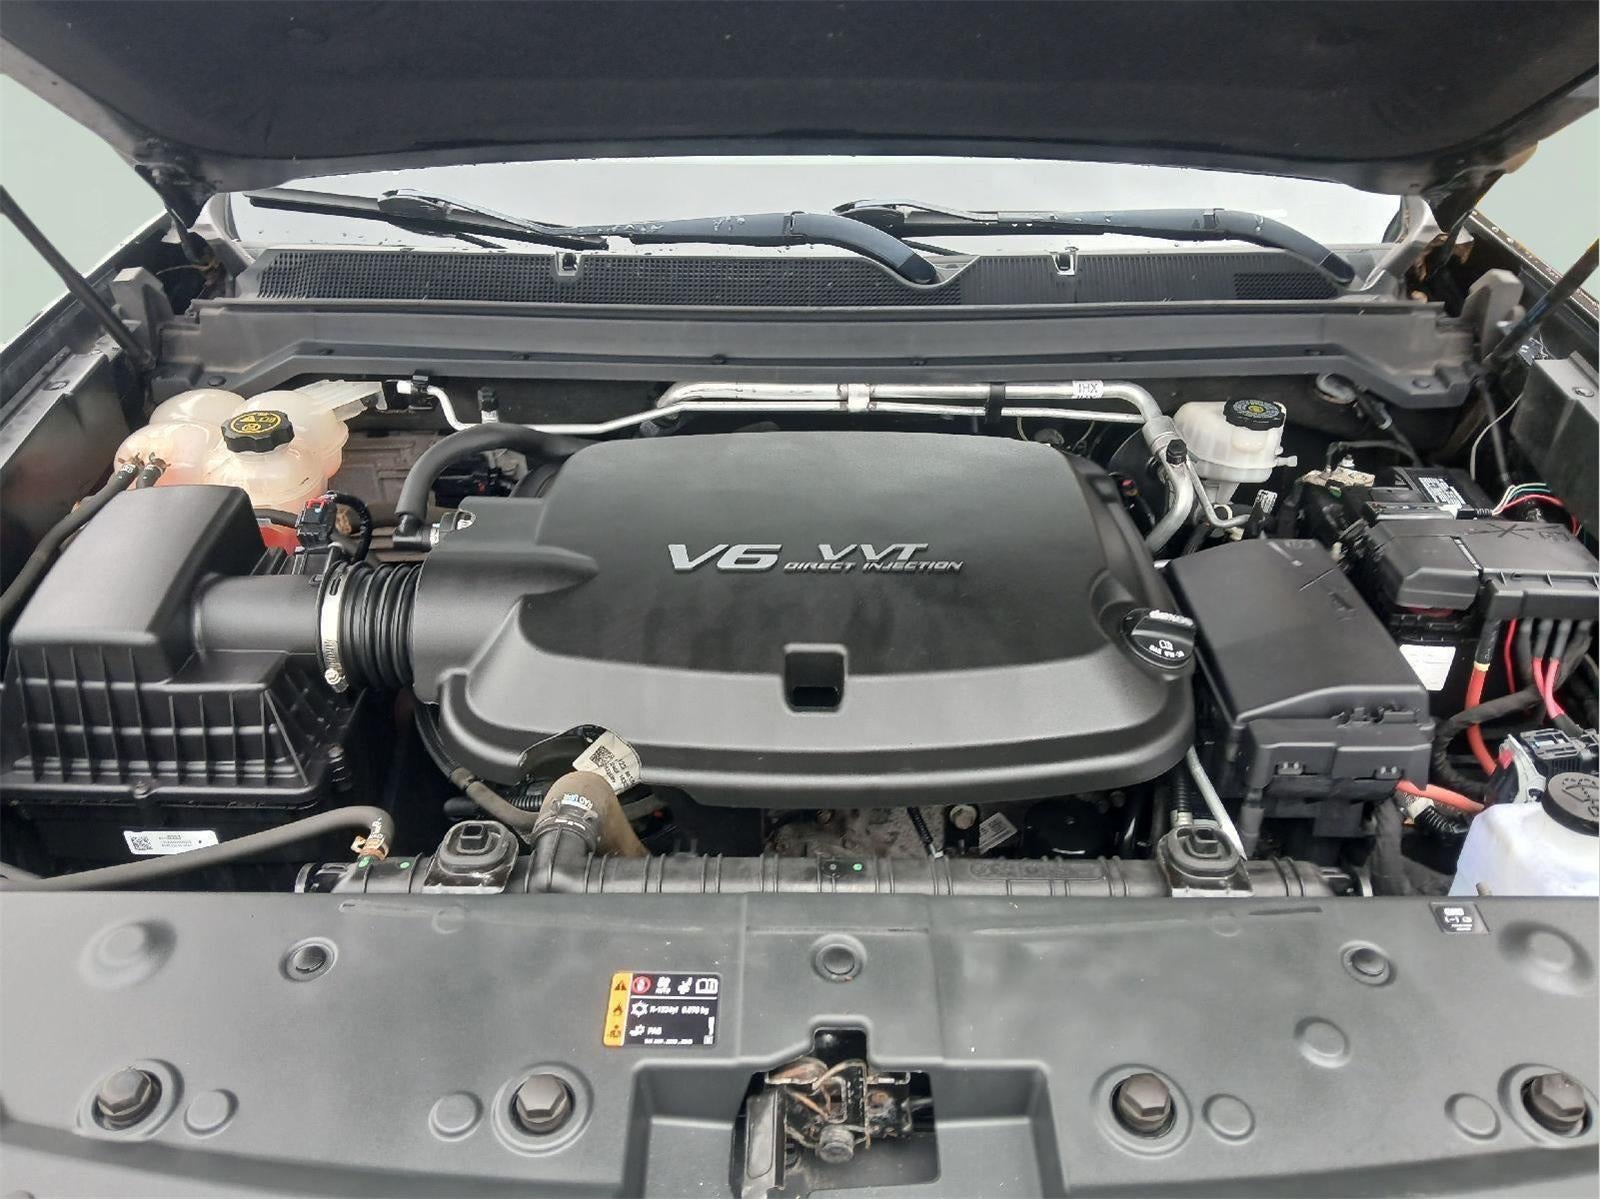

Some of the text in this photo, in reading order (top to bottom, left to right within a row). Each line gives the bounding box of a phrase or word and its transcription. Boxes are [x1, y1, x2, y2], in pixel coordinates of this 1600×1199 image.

[667, 543, 929, 571] V6 VVT
[783, 560, 964, 573] DIRECT INJECTION
